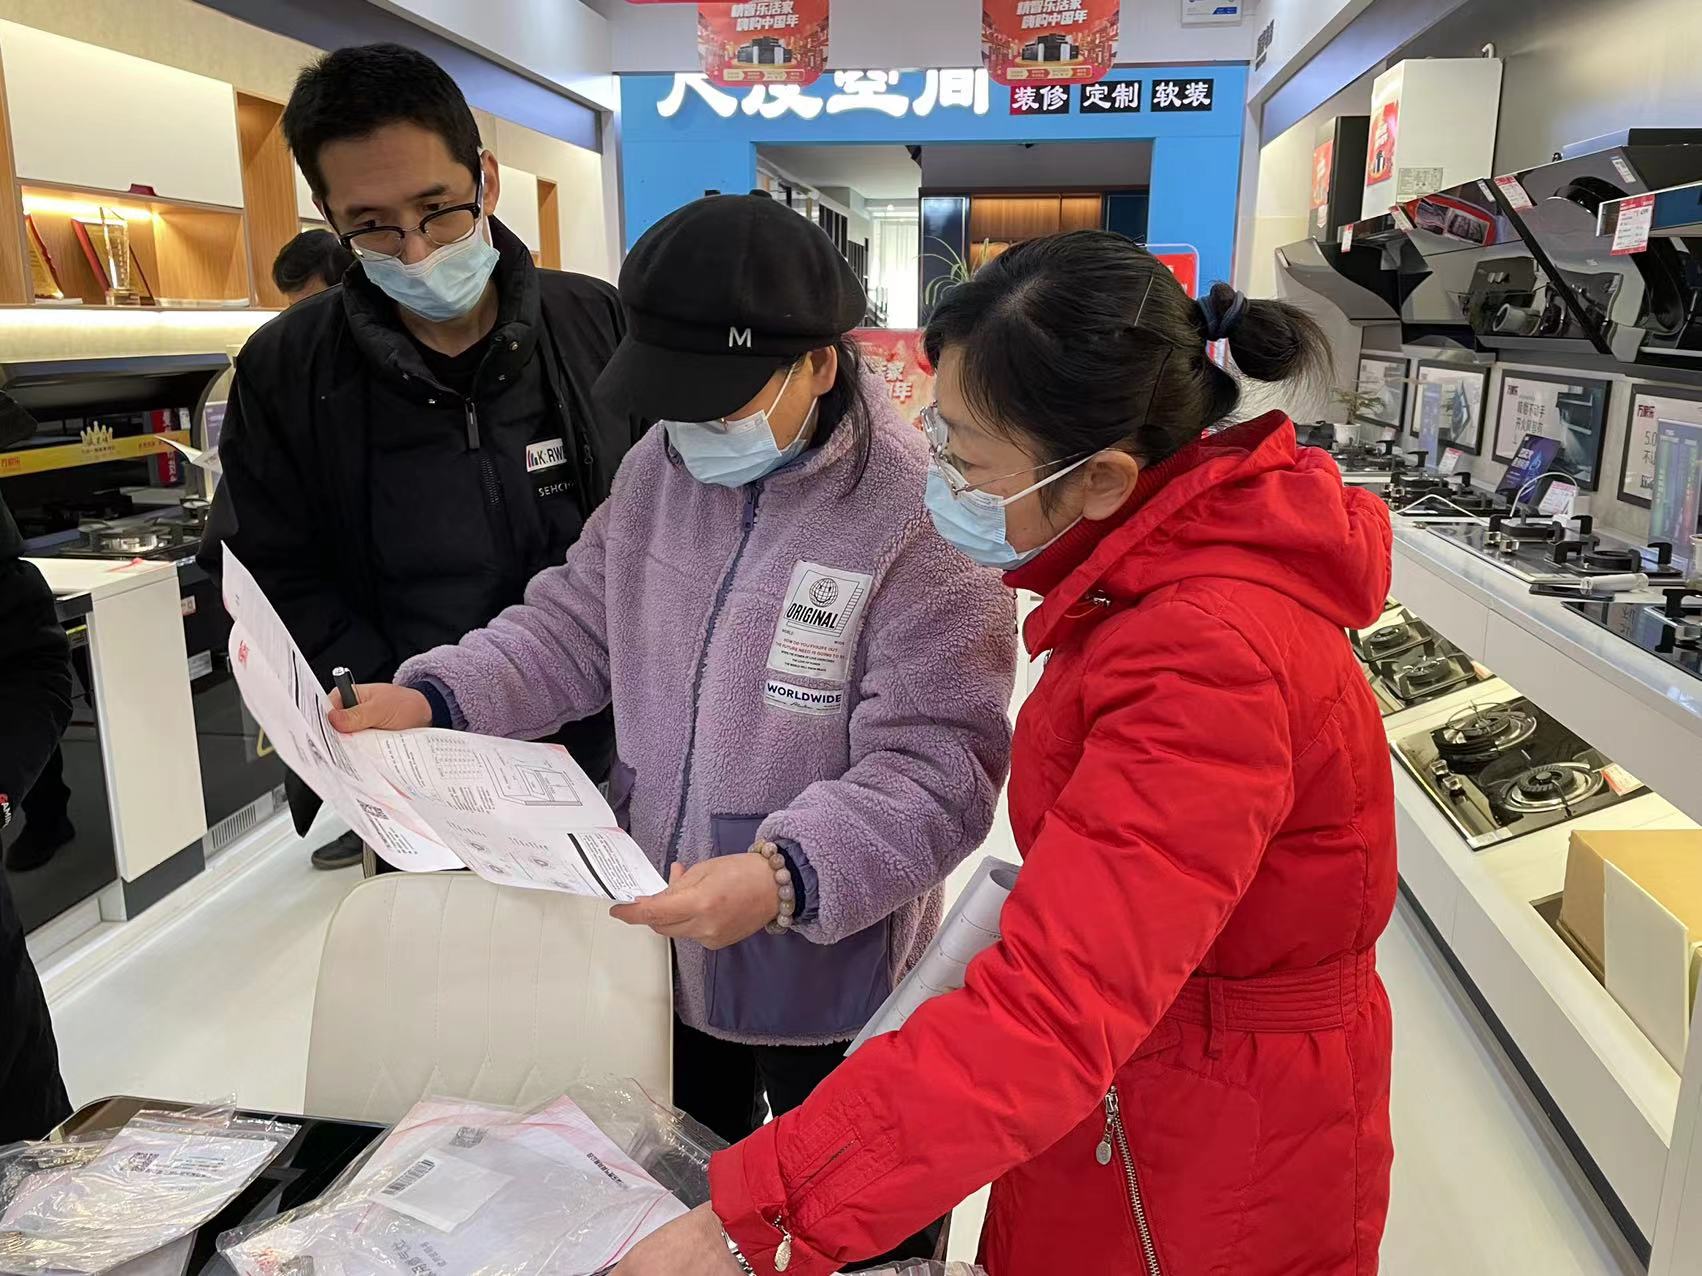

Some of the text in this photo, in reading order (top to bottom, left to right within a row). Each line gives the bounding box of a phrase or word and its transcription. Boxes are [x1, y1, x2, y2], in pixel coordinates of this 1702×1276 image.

[1011, 81, 1211, 111] 装修 定制 软装
[729, 326, 752, 348] M
[786, 602, 838, 629] ORIGINAL
[767, 683, 842, 704] WORLDWIDE
